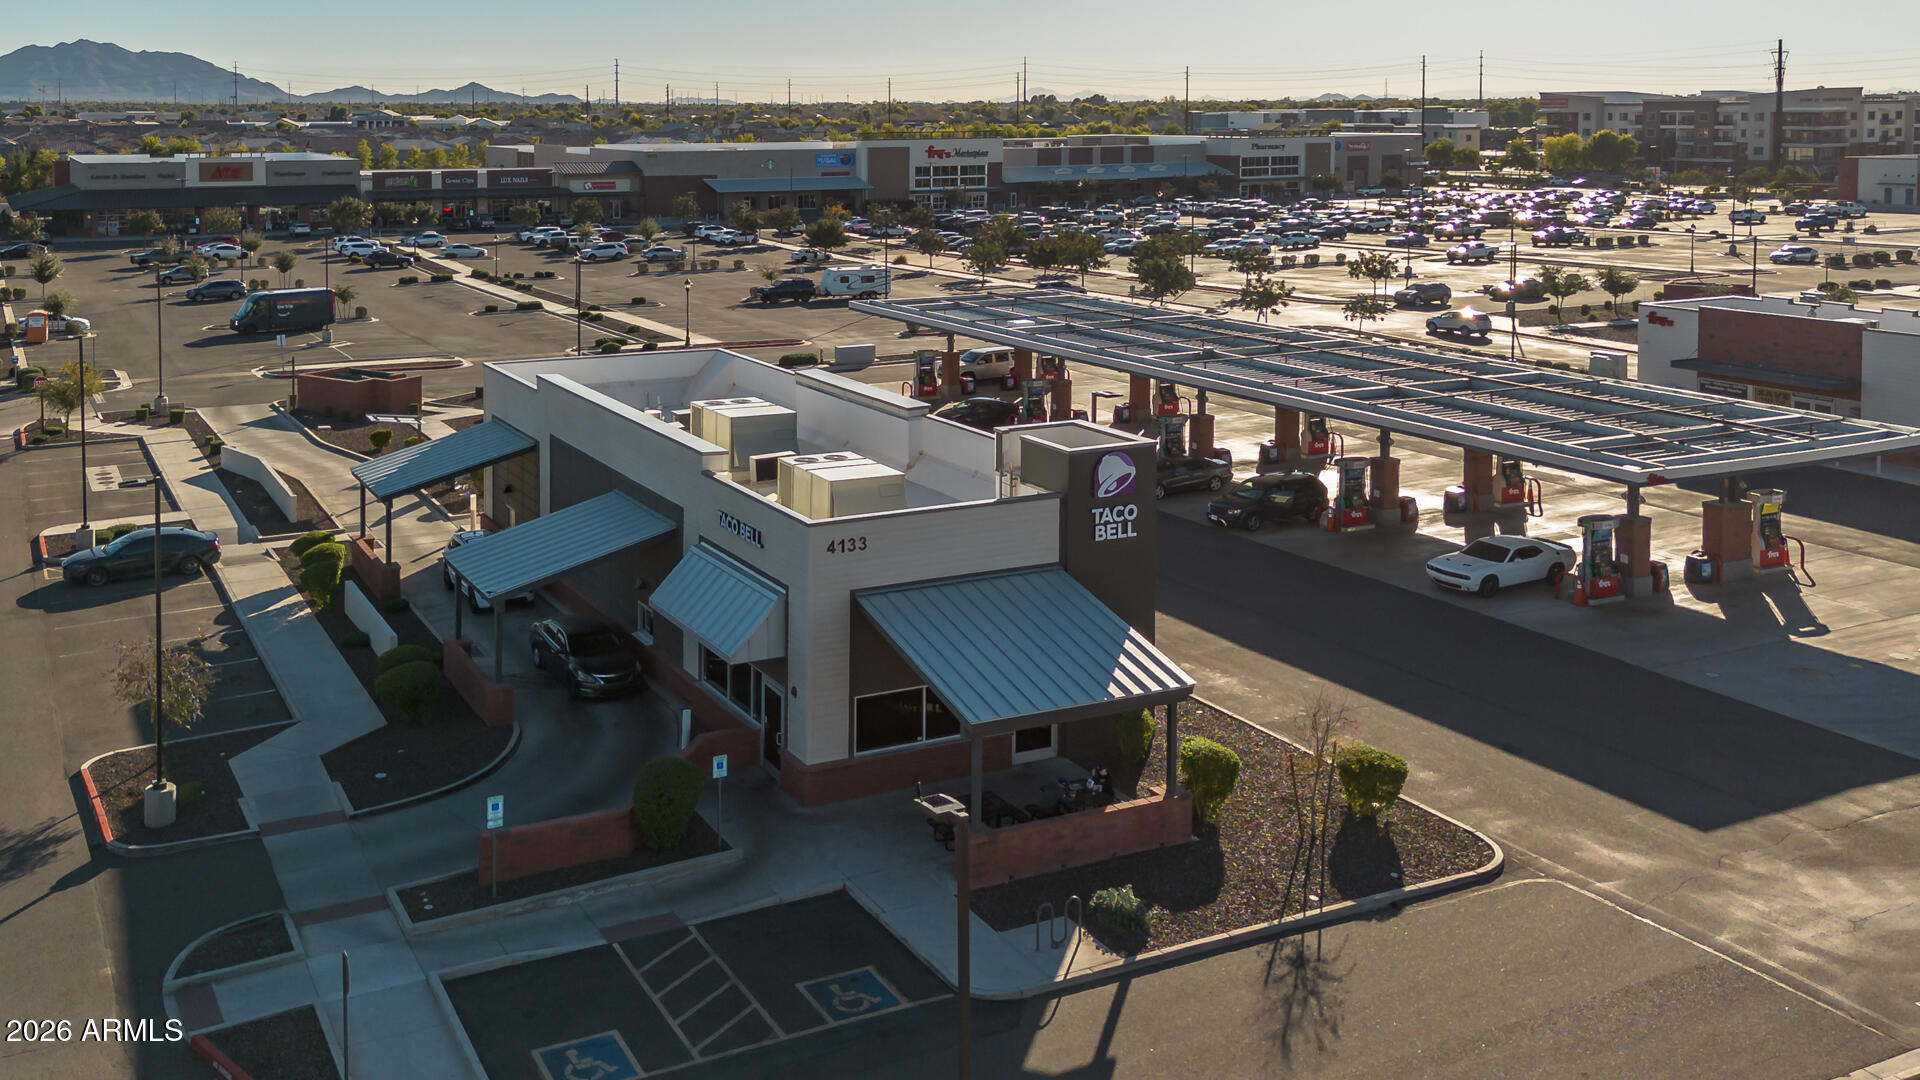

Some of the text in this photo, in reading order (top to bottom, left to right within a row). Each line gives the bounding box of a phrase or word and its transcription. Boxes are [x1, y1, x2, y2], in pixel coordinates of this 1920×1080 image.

[925, 145, 952, 159] fry's
[1251, 143, 1285, 151] Pharmacy
[210, 167, 242, 179] ACE
[1092, 504, 1138, 525] TACO
[717, 509, 764, 548] TACO BELL
[1095, 521, 1137, 541] BELL
[826, 536, 868, 554] 4133
